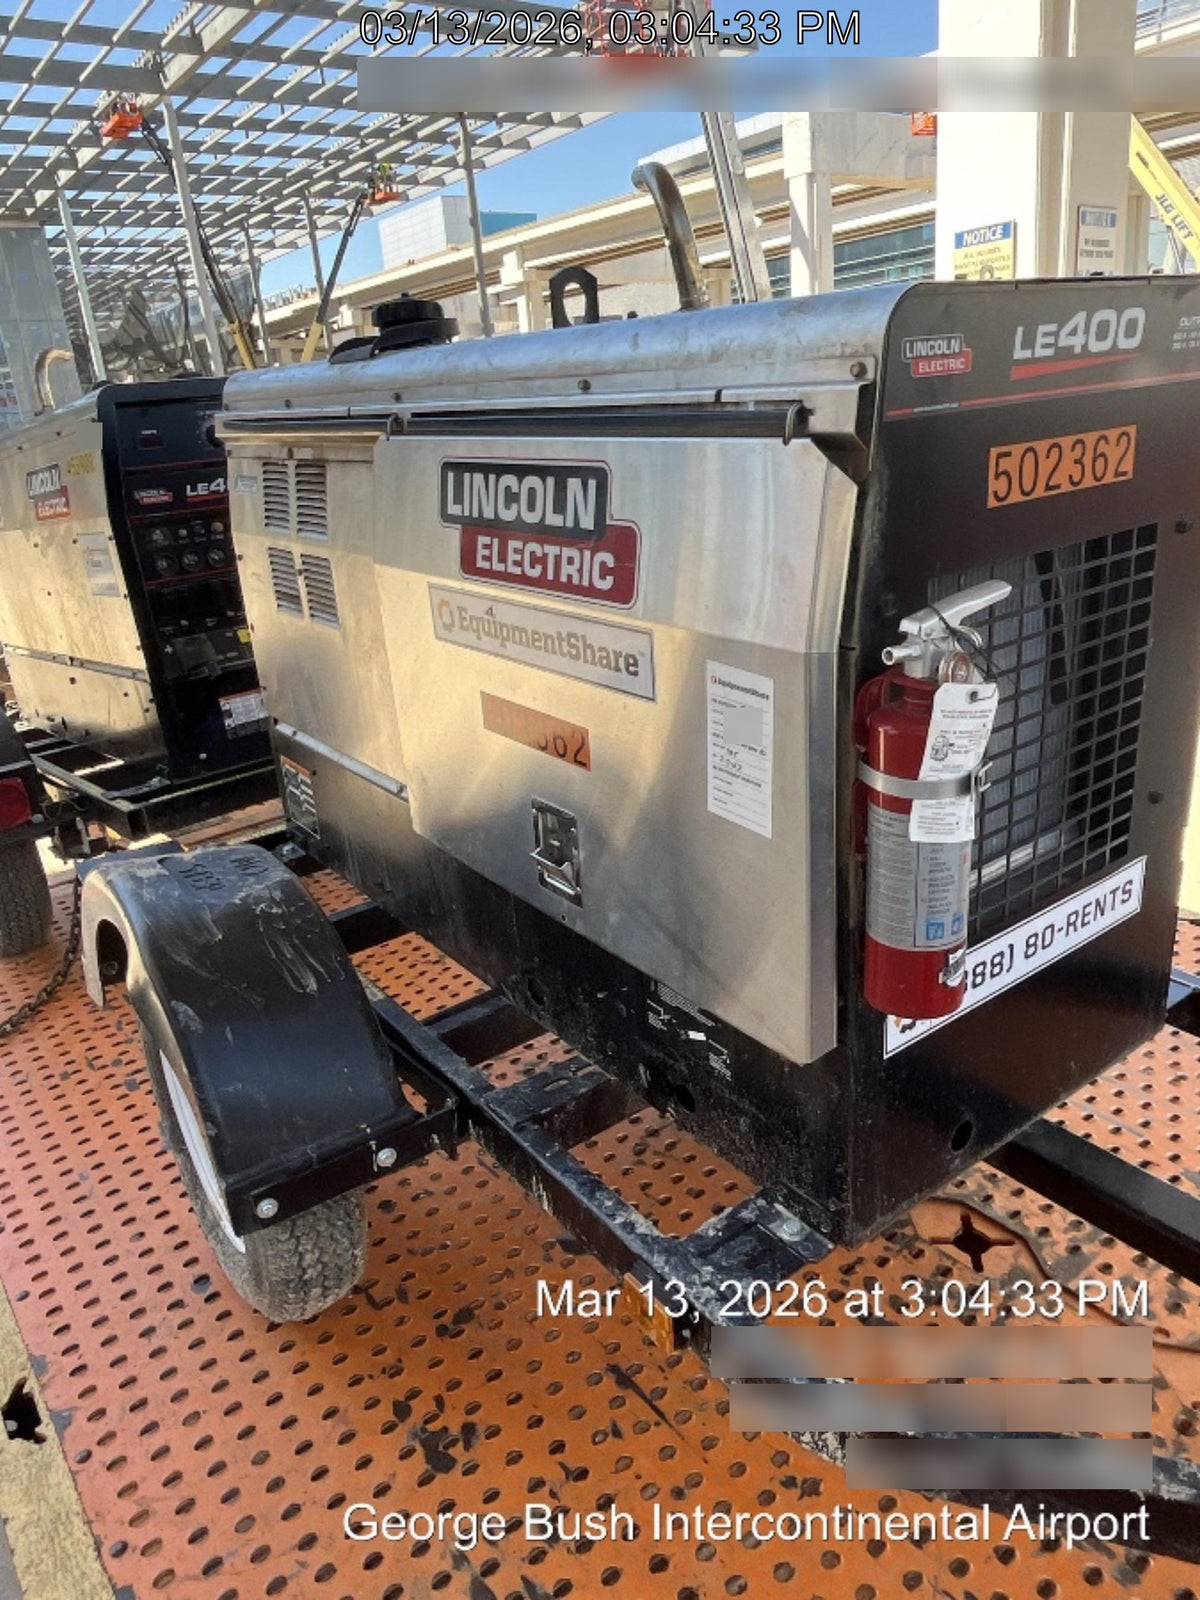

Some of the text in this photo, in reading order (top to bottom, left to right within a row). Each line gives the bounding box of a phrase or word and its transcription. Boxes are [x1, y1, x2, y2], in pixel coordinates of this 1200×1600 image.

[963, 225, 1003, 247] NOTICE
[905, 338, 961, 358] LINCOLN
[1012, 307, 1146, 360] LE400
[918, 357, 966, 373] ELECTRIC
[992, 431, 1132, 503] 502362
[447, 470, 597, 531] LINCOLN
[475, 535, 616, 591] ELECTRIC
[456, 605, 640, 677] EquipmentShare
[963, 943, 1014, 994] 88)
[1023, 878, 1134, 960] 80-RENTS
